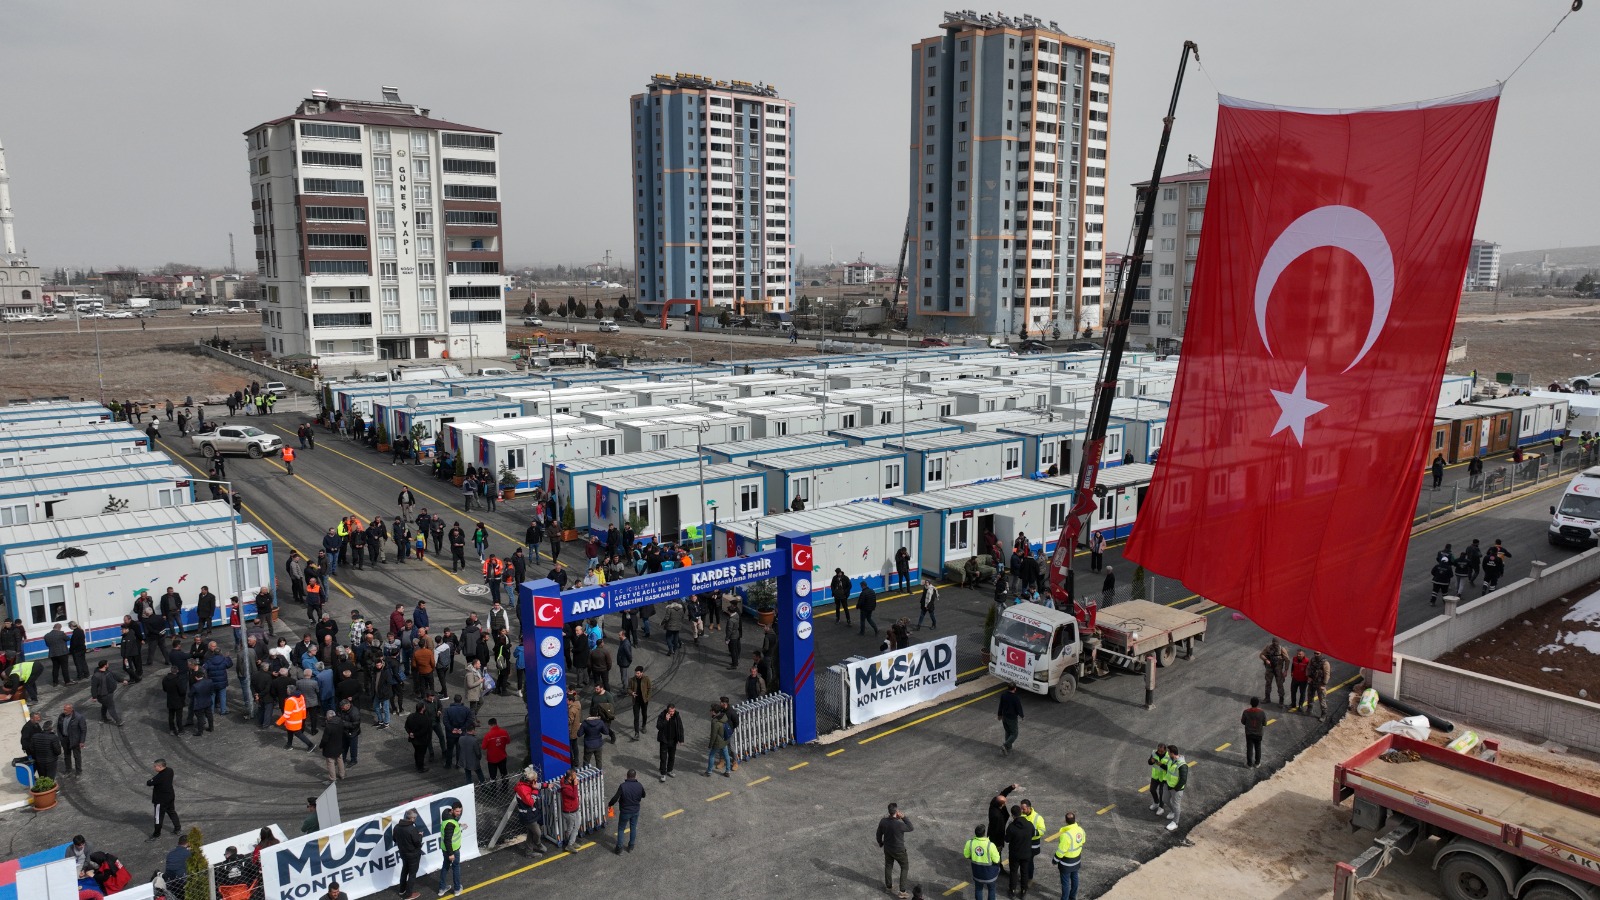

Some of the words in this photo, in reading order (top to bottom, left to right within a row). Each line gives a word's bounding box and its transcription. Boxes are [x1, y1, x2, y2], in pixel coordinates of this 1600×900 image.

[399, 166, 407, 211] GÜNEŞ
[691, 565, 737, 584] KARDEŞ
[739, 558, 771, 576] ŞEHİR
[691, 581, 712, 591] Geçici
[713, 574, 746, 587] Konaklama
[747, 569, 770, 580] Merkezi
[614, 593, 631, 602] AFET
[642, 587, 657, 596] ACİL
[658, 583, 680, 592] DURUM
[614, 596, 644, 608] YÖNETİMİ
[644, 589, 680, 602] BAŞKANLIĞI
[572, 597, 605, 615] AFAD
[857, 678, 920, 708] KONTEYNER
[922, 670, 951, 686] KENT
